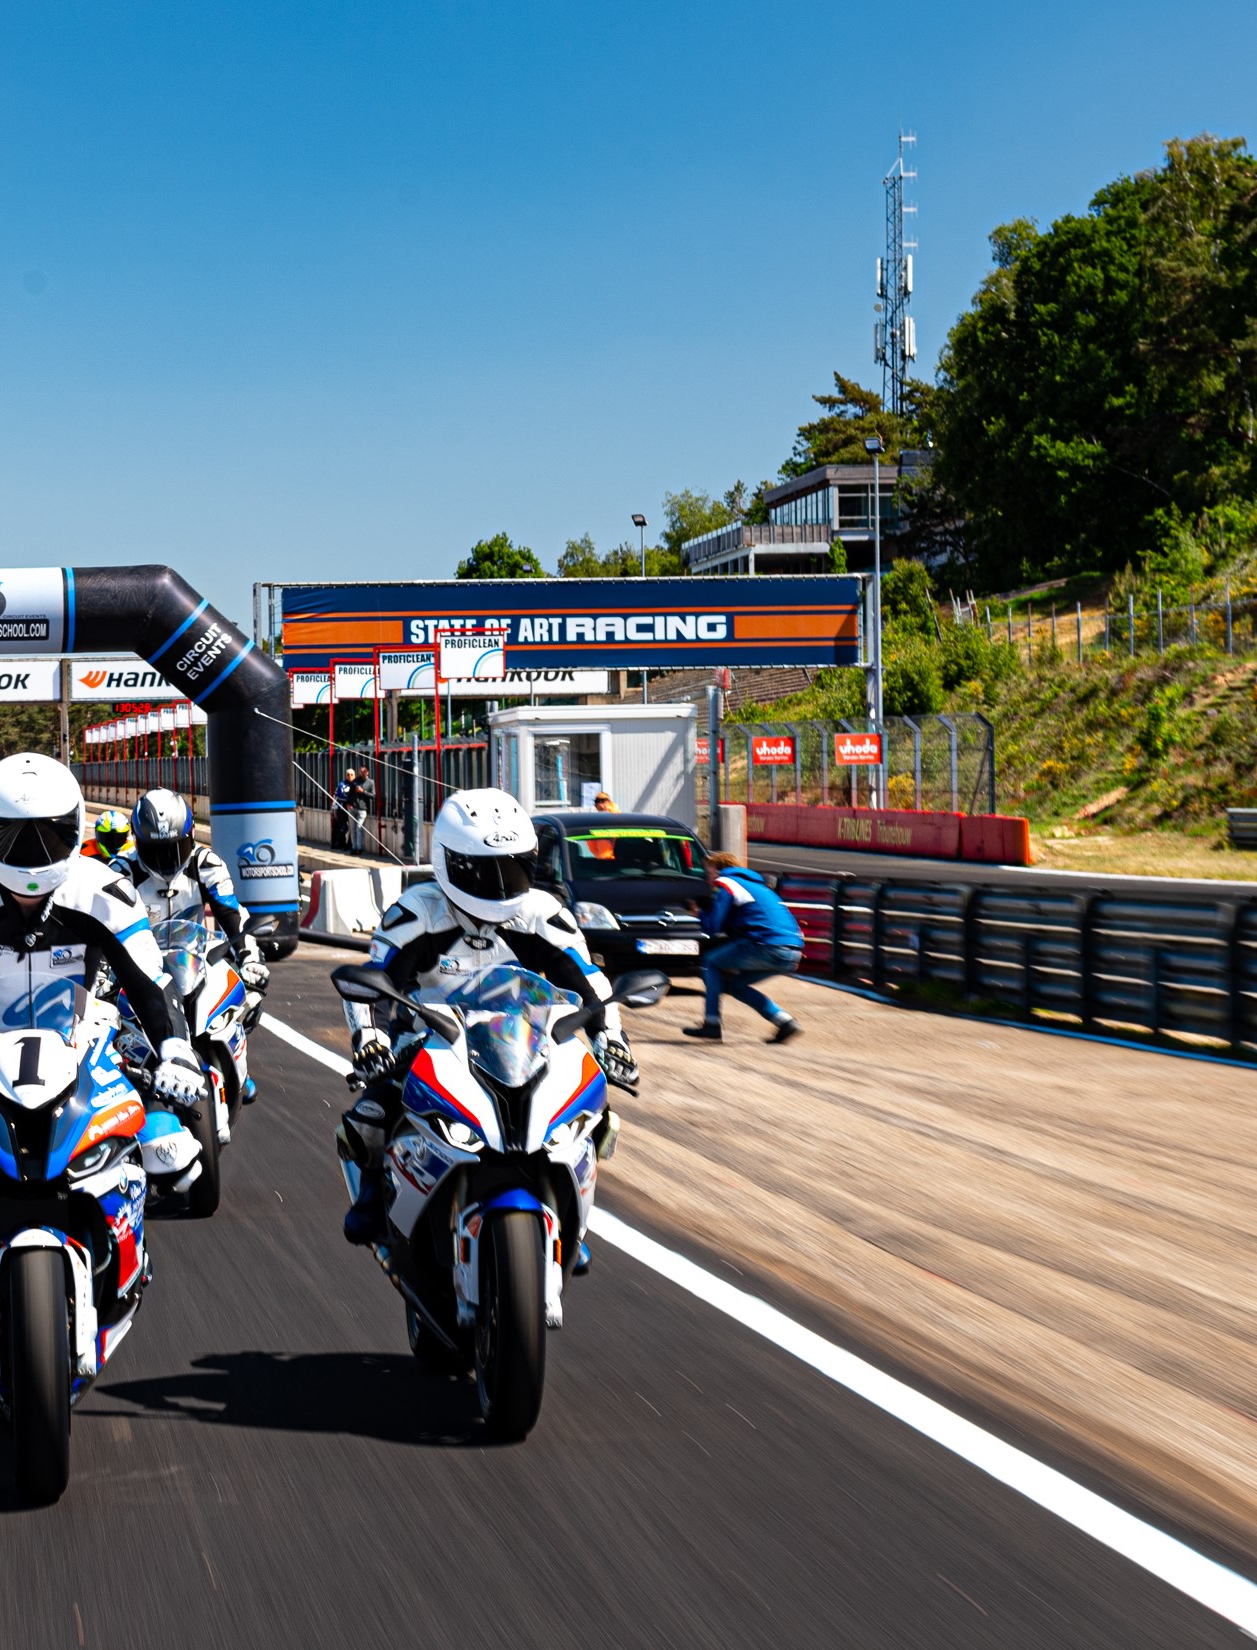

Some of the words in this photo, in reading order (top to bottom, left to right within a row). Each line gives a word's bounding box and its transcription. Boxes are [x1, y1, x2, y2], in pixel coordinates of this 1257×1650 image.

[518, 617, 563, 642] ART
[566, 615, 727, 641] RACING
[176, 622, 222, 671] CIRCUIT
[444, 638, 500, 649] PROFICLEAN
[186, 633, 233, 681] EVENTS
[382, 654, 432, 664] PROFICLEAN
[338, 666, 380, 675] PROFICLE
[756, 740, 792, 756] uhoda
[839, 738, 878, 754] uhoda
[12, 1036, 46, 1086] 1
